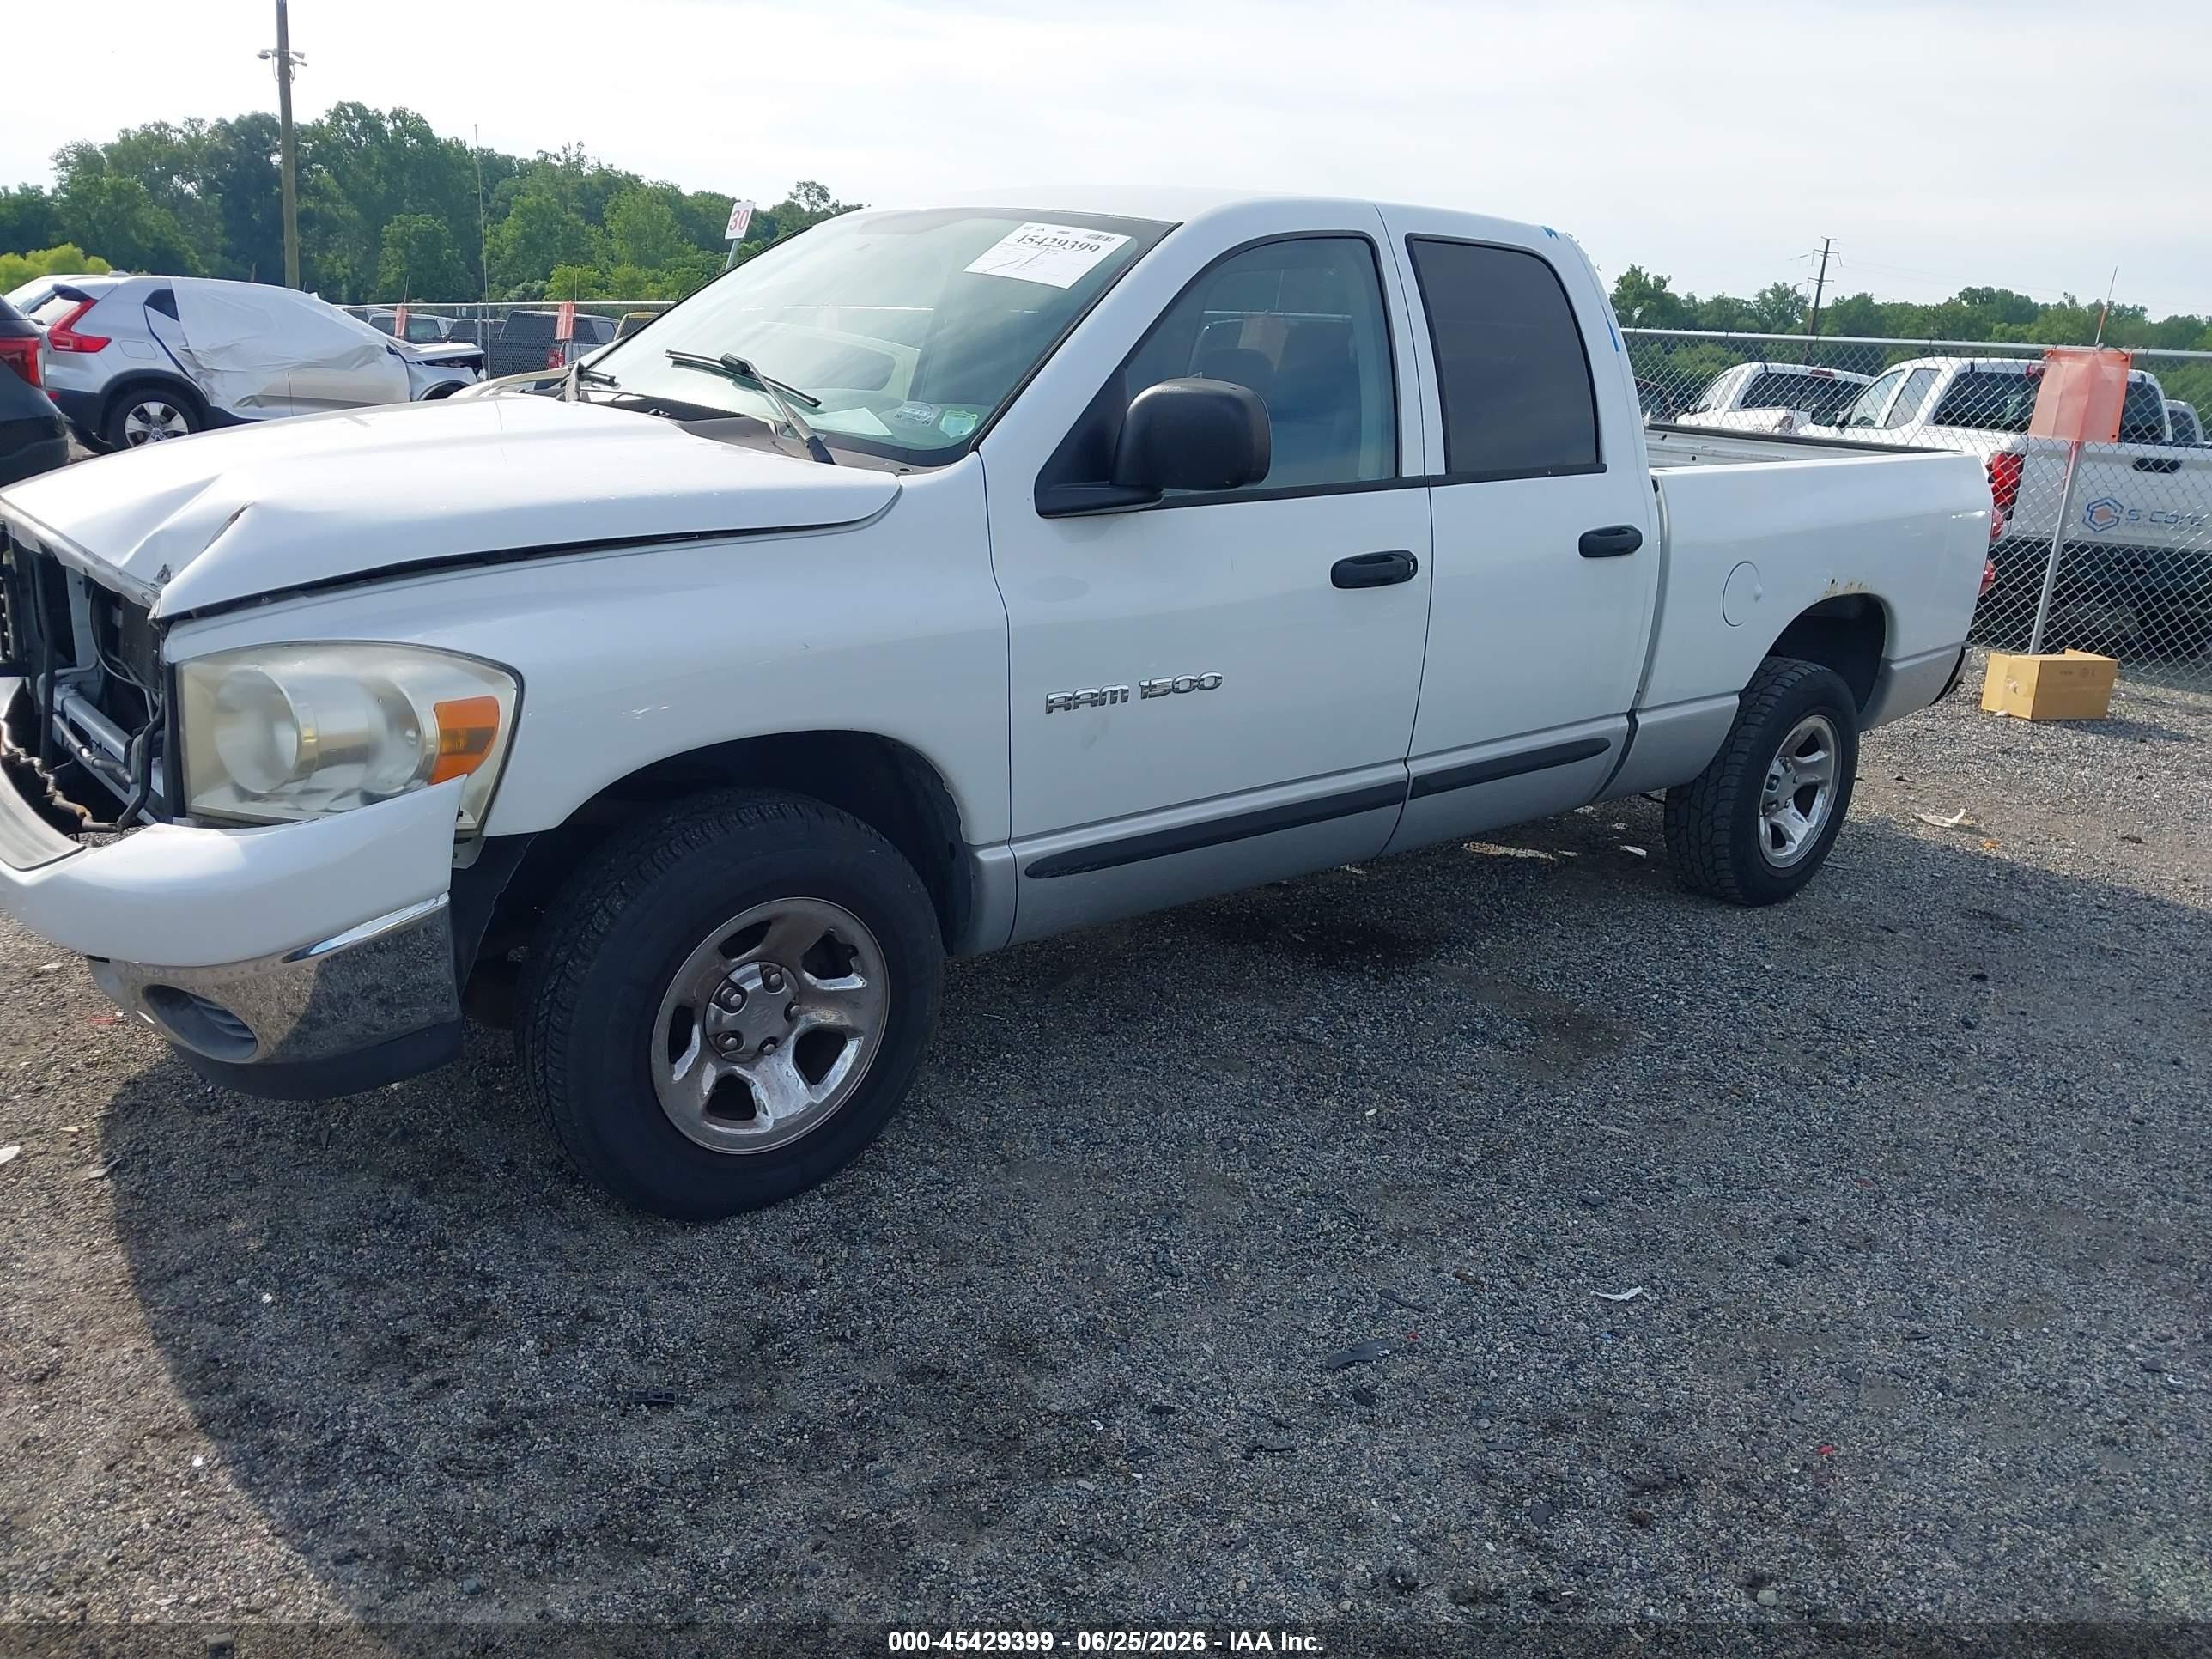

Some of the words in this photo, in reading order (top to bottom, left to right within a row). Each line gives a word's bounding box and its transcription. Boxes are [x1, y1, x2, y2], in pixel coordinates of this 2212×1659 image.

[728, 209, 750, 231] 30
[1013, 233, 1102, 254] 45429399
[1045, 684, 1130, 714] RAM
[1139, 671, 1224, 700] 1500
